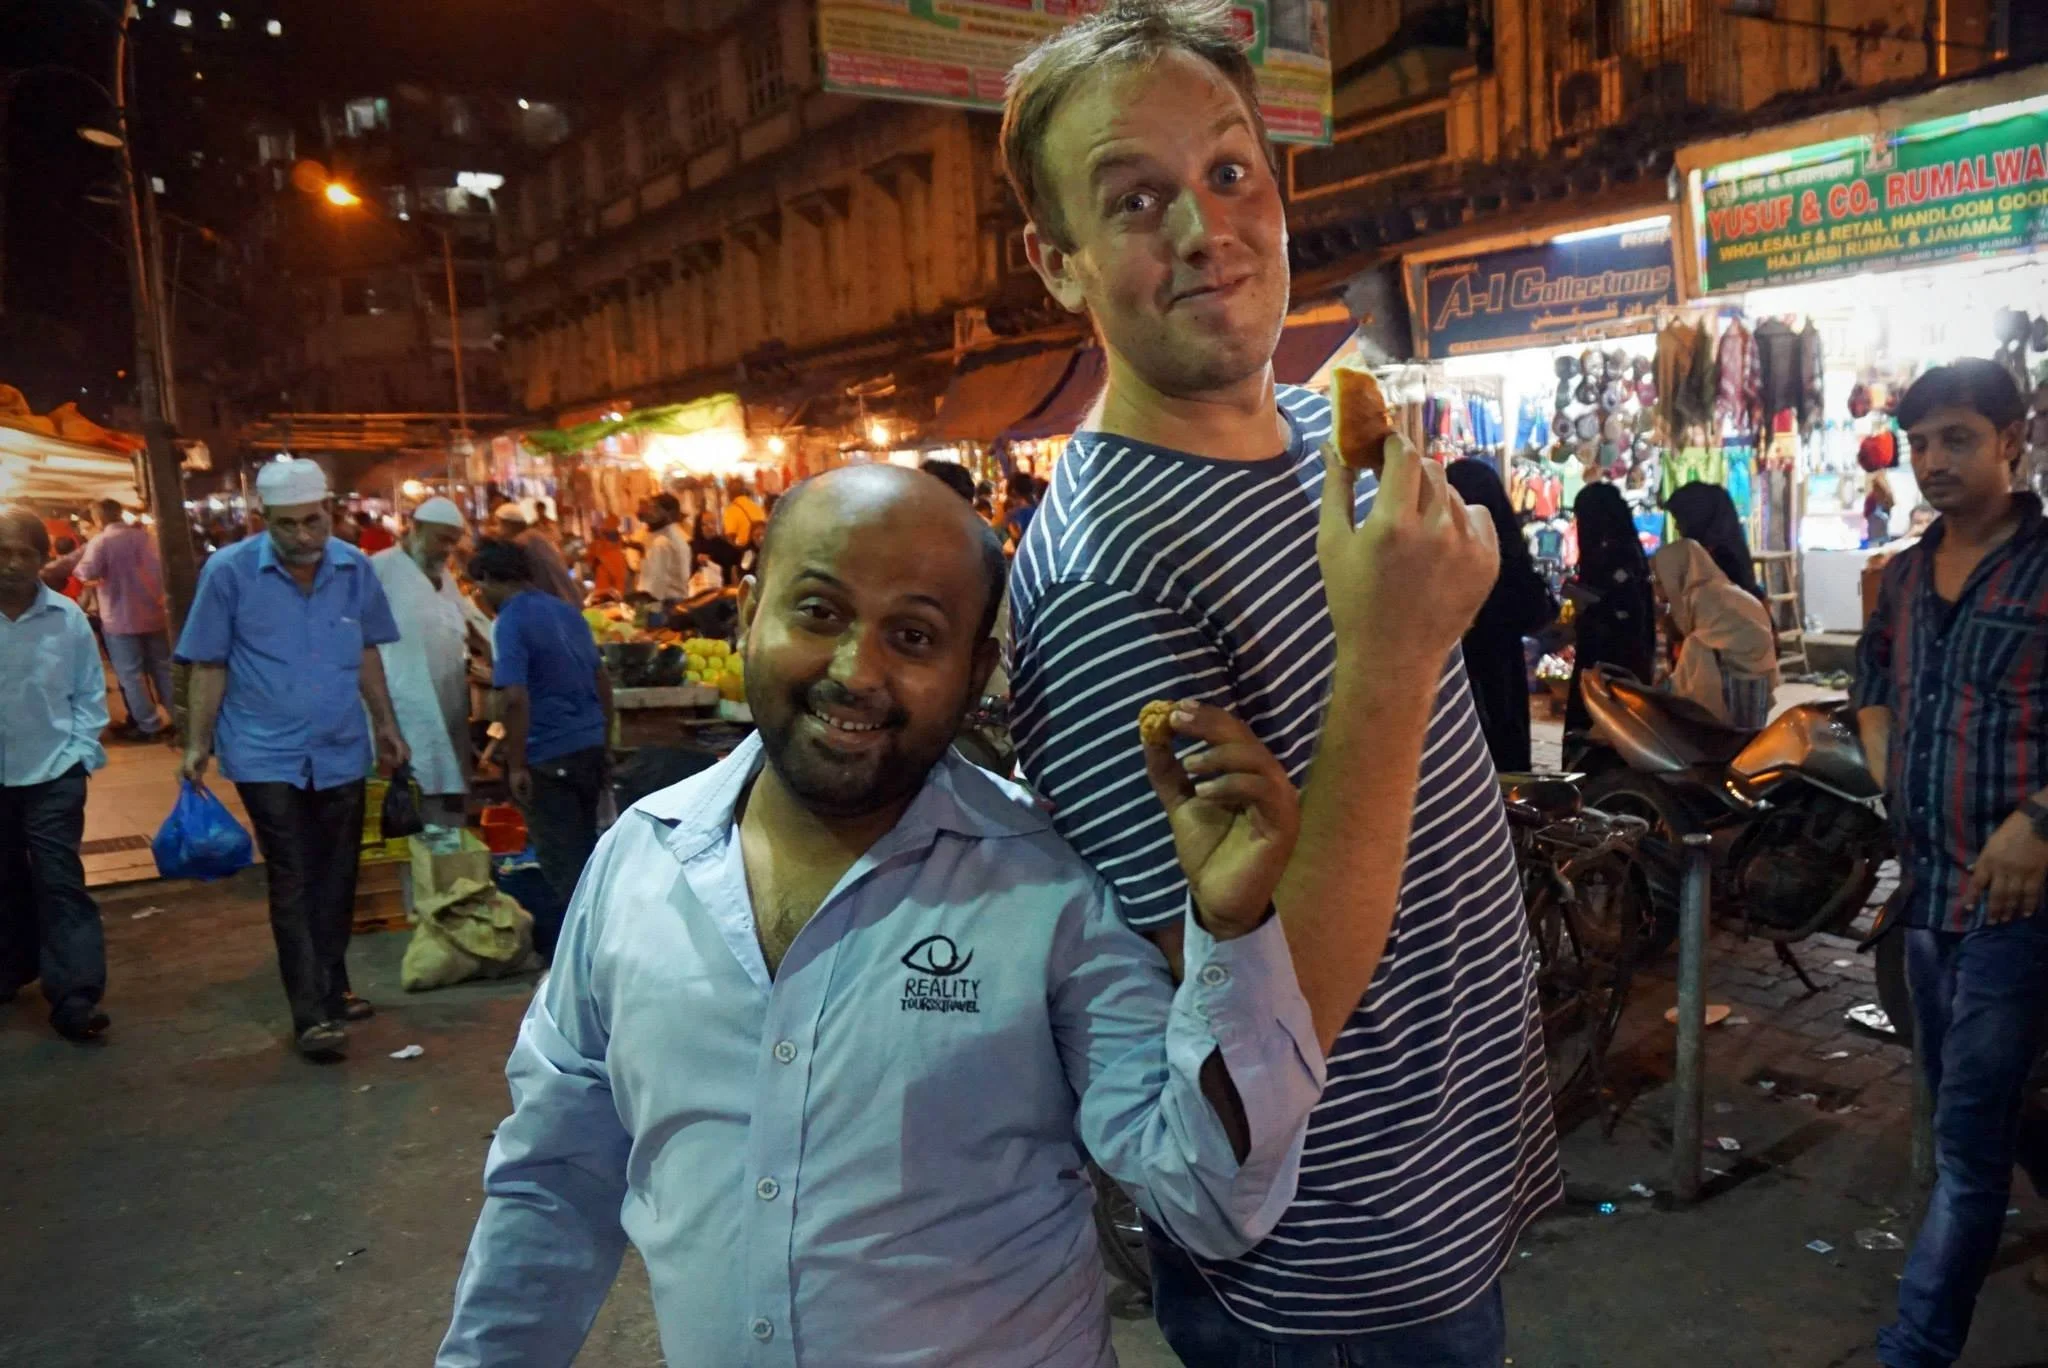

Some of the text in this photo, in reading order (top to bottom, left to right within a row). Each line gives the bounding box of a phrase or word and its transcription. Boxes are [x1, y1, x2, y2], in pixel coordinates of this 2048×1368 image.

[1708, 194, 1794, 242] YUSUF
[1801, 190, 1822, 225] &
[1828, 179, 1879, 220] CO.
[1885, 142, 2048, 210] RUMALWA
[1720, 231, 1812, 262] WHOLESALE
[1815, 229, 1827, 246] &
[1830, 218, 1887, 242] RETAIL
[1892, 198, 1994, 231] HANDLOOM
[1767, 251, 1800, 271] HAJI
[1805, 244, 1843, 265] ARBI
[1846, 234, 1904, 258] RUMAL
[1908, 230, 1921, 247] &
[1924, 214, 2013, 245] JANAMAZ
[1511, 265, 1672, 308] Collections
[904, 978, 980, 999] REALITY
